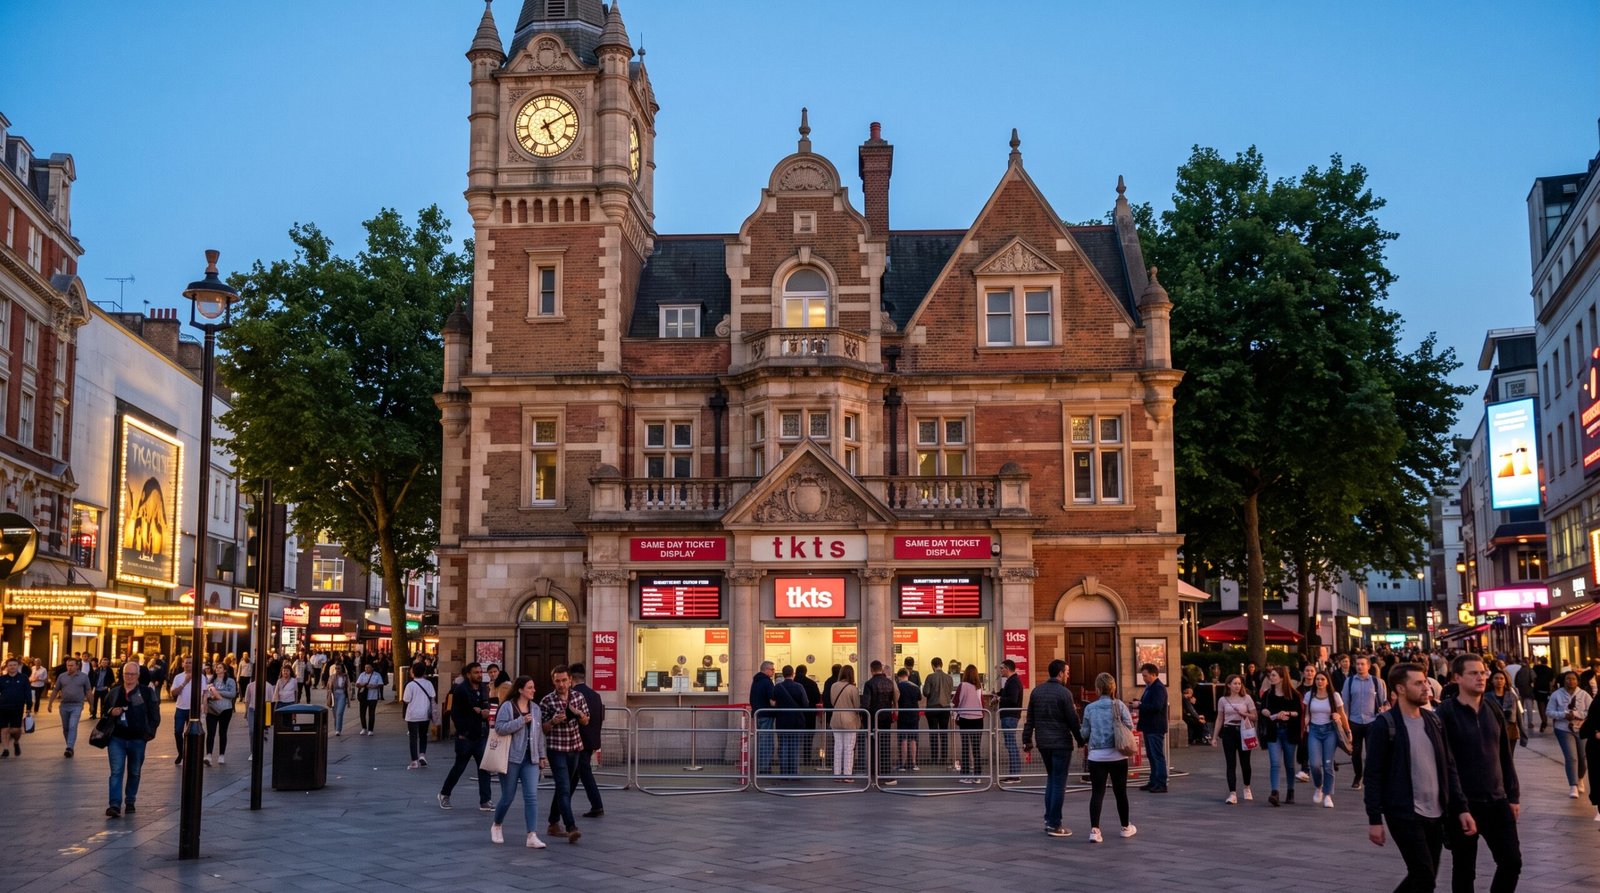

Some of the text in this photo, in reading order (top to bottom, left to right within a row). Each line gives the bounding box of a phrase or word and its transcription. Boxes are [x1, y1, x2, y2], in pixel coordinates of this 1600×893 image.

[640, 541, 716, 549] SAME DAY TICKET
[772, 535, 846, 559] tkts
[905, 539, 981, 548] SAME DAY TICKET
[660, 550, 696, 558] DISPLAY
[925, 548, 962, 556] DISPLAY
[785, 586, 833, 608] tkts
[594, 633, 615, 644] tkts
[1005, 631, 1027, 642] tkts
